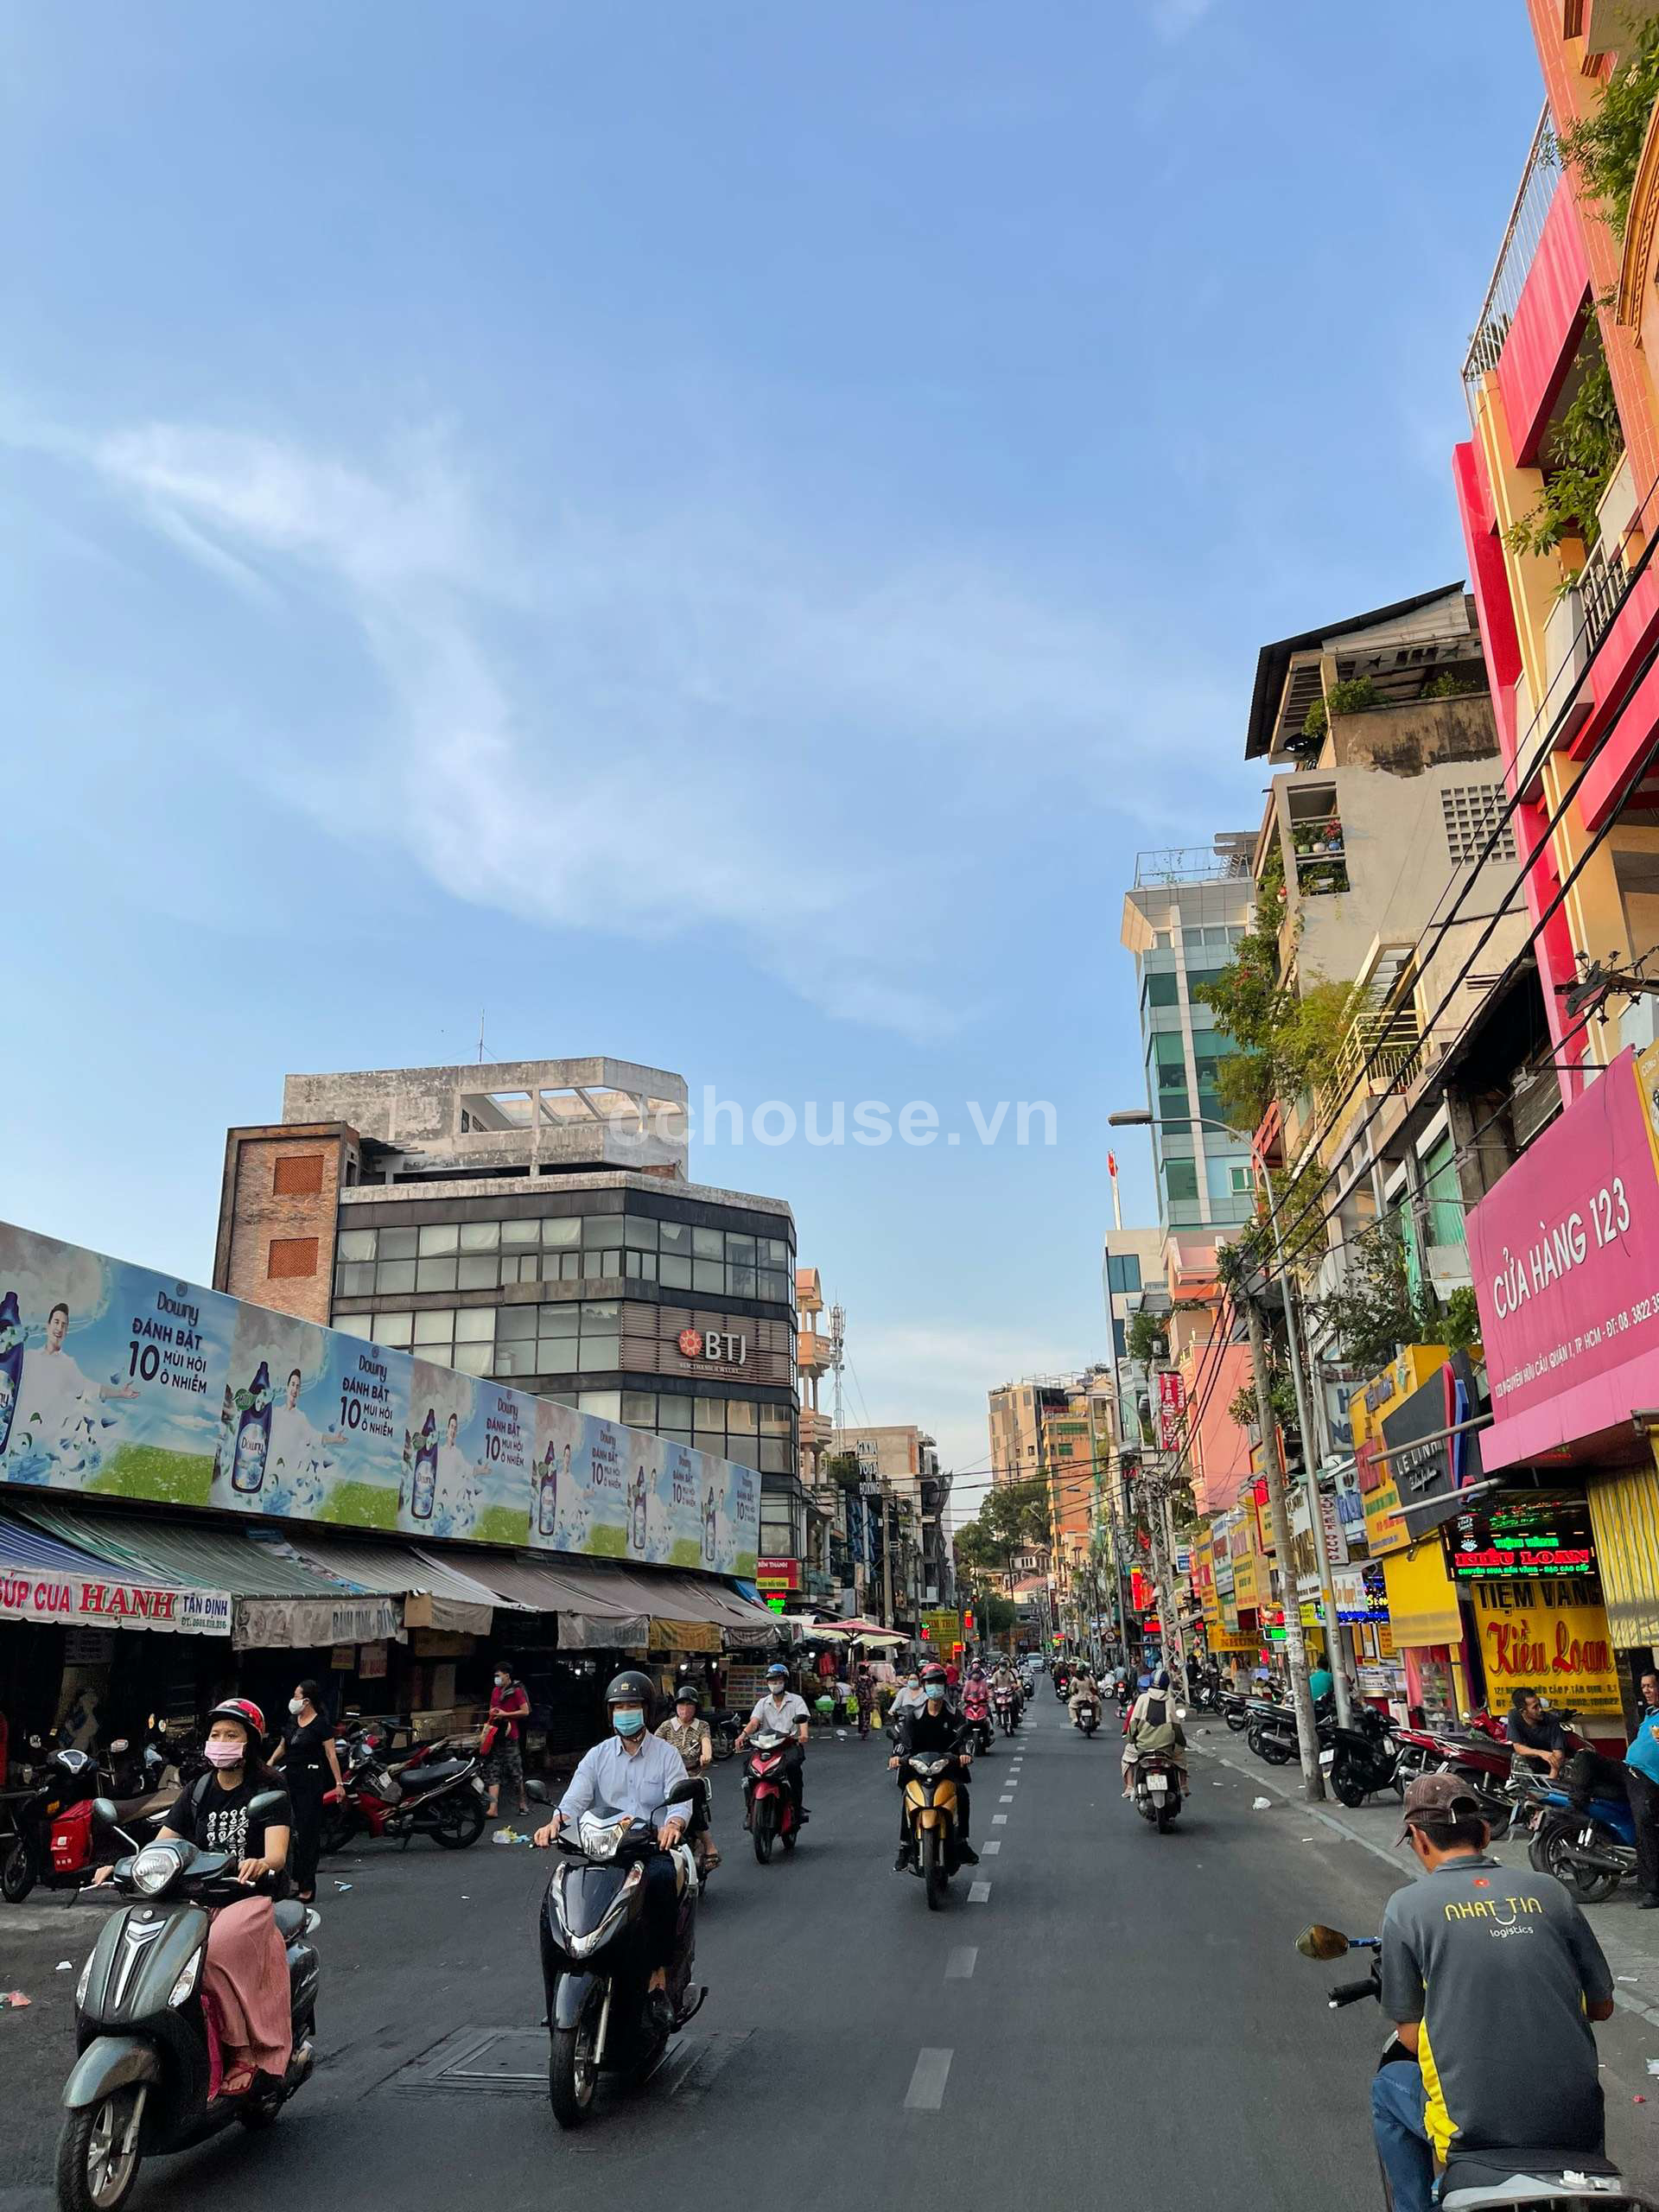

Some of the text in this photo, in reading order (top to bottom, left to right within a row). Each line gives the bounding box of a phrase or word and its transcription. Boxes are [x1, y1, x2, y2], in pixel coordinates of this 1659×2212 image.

[1494, 1177, 1630, 1319] CỬA HÀNG 123
[157, 1291, 200, 1327] Downy
[1584, 1326, 1602, 1349] HCM
[1630, 1299, 1652, 1325] 3822
[132, 1317, 203, 1352] ĐÁNH BẬT
[705, 1331, 747, 1365] BTJ
[130, 1340, 161, 1382] 10
[162, 1349, 207, 1374] MÙI HÔI
[359, 1354, 387, 1383] Downy
[160, 1368, 207, 1395] Ô NHIỄM
[342, 1376, 390, 1404] ĐÁNH BẬT
[340, 1395, 362, 1429] 10
[486, 1433, 500, 1462] 10
[592, 1461, 604, 1485] 10
[672, 1482, 683, 1504] 10
[34, 1582, 71, 1613] CUA
[79, 1583, 177, 1622] HẠNH
[183, 1592, 203, 1614] TÂN
[205, 1598, 228, 1619] ĐỊNH
[1487, 1618, 1616, 1676] Kiều Loan
[1444, 1897, 1542, 1922] NHAT TIN
[1489, 1925, 1535, 1938] logistics
